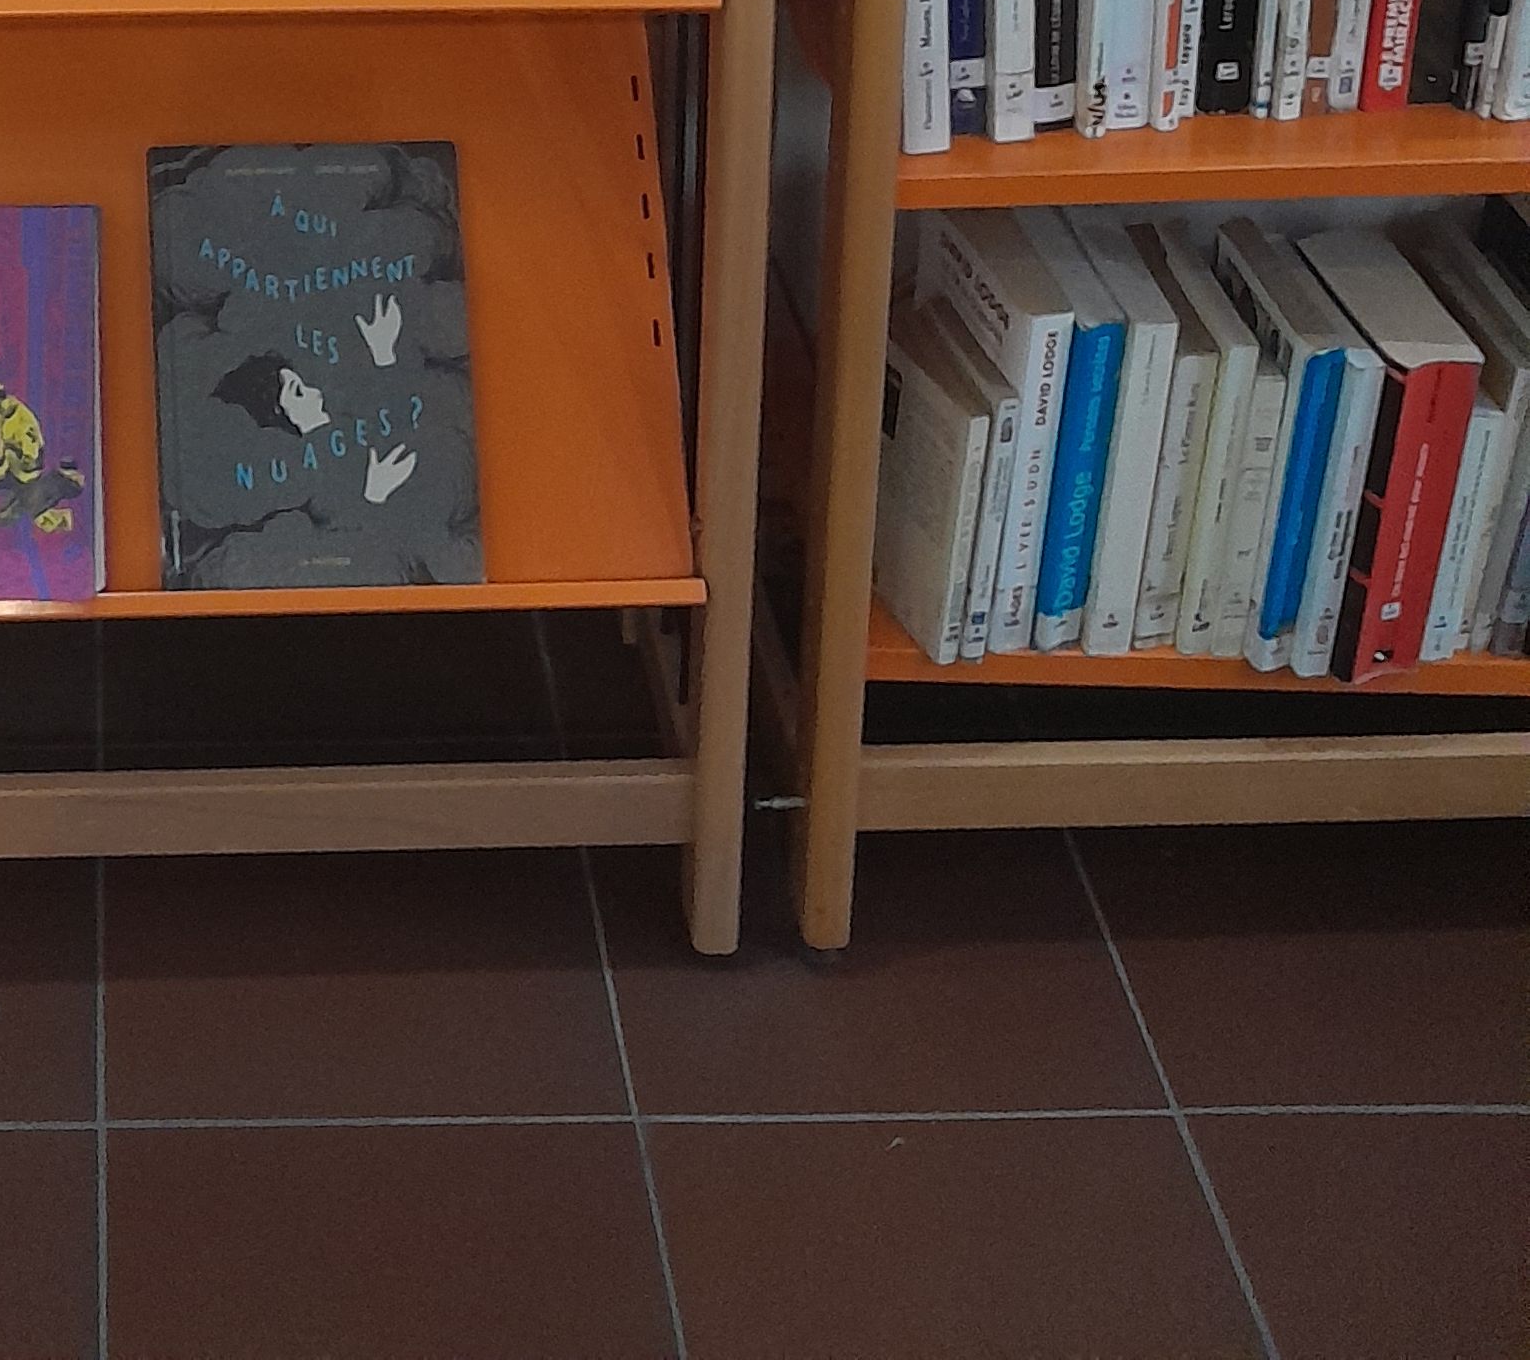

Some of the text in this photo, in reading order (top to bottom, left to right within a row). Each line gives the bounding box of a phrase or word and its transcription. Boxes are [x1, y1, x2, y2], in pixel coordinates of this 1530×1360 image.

[294, 209, 338, 238] QUI
[199, 237, 416, 303] APPARTIENNENT
[295, 323, 340, 364] LES
[1034, 329, 1058, 427] DAVID LODGE
[1054, 472, 1094, 611] David Lodge
